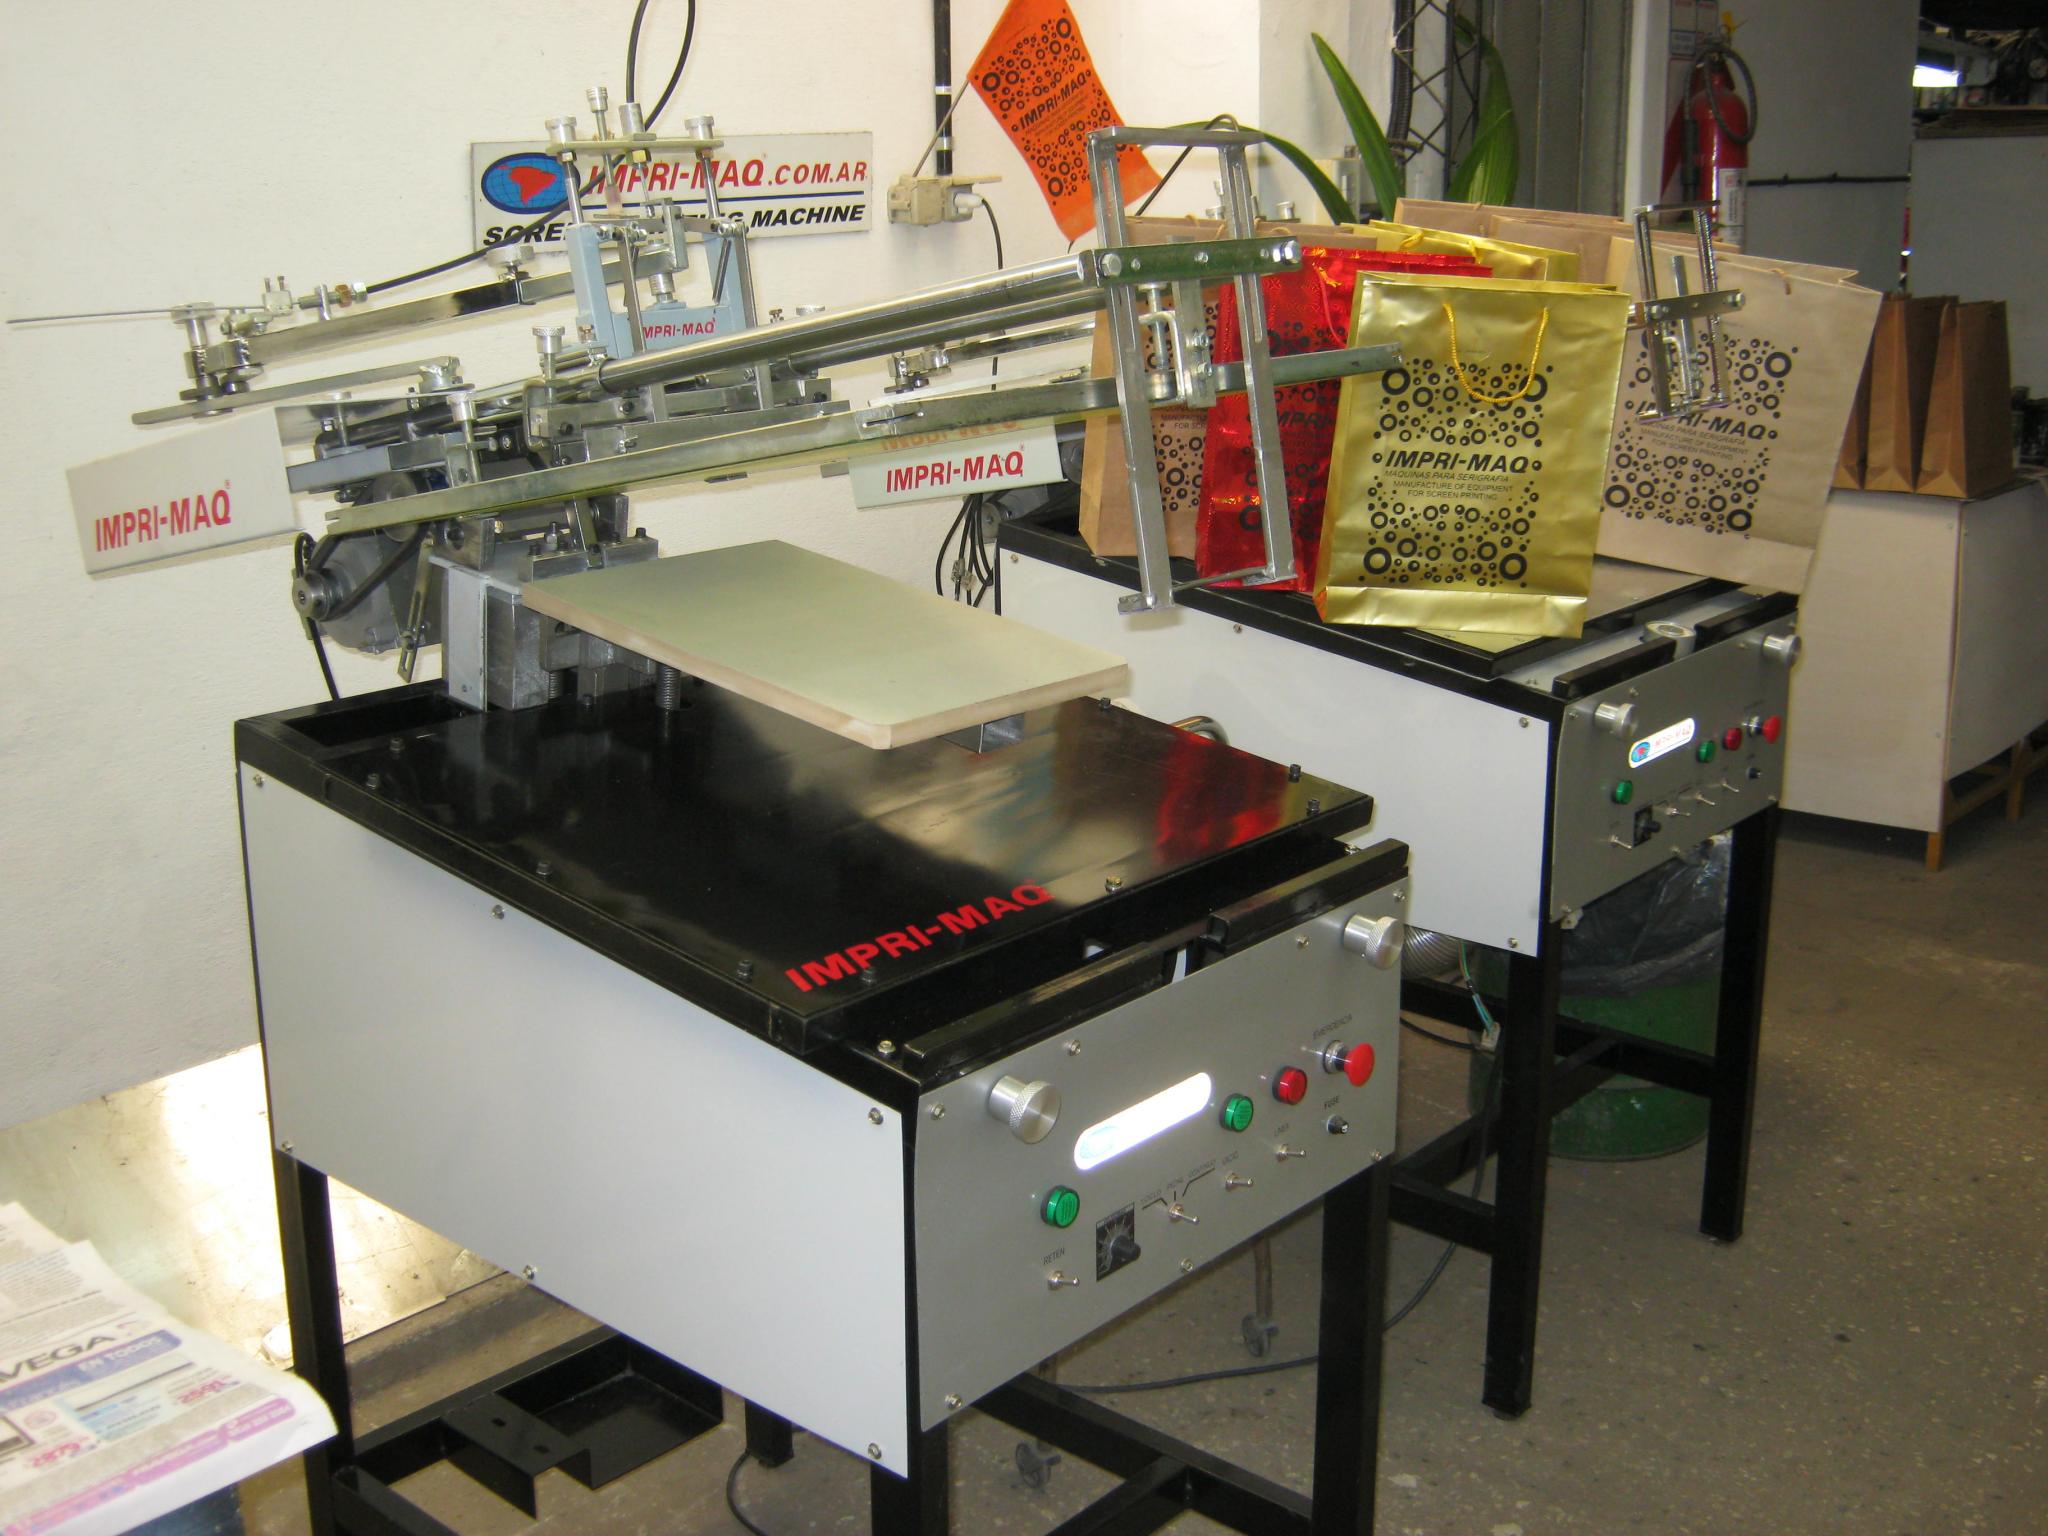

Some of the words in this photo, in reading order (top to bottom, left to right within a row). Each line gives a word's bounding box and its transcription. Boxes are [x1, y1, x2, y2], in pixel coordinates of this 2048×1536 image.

[1020, 72, 1087, 130] IMPRI-MAQ
[483, 222, 574, 246] SCRE
[751, 204, 866, 228] MACHINE
[642, 321, 715, 339] MPRI-MAQ
[1174, 422, 1190, 430] FOR
[1191, 422, 1208, 431] SCR
[1636, 400, 1767, 440] IRI-MAQ
[886, 450, 1023, 493] IMPRI-MAQ
[1385, 450, 1529, 474] IMPRI-MAQ
[1432, 472, 1456, 481] PARA
[1456, 472, 1509, 483] SERIGRAFIA
[1393, 480, 1451, 490] MANUFACTURE
[1467, 483, 1513, 493] EQUIPMENT
[1407, 489, 1424, 497] FOR
[1426, 490, 1459, 499] SCREEN
[1460, 491, 1498, 501] PRINTING
[95, 489, 231, 552] IMPRI-MAQ
[784, 884, 1056, 993] IMPRI-MAQ
[1042, 1246, 1066, 1266] RETEN
[0, 1336, 116, 1384] VEGA
